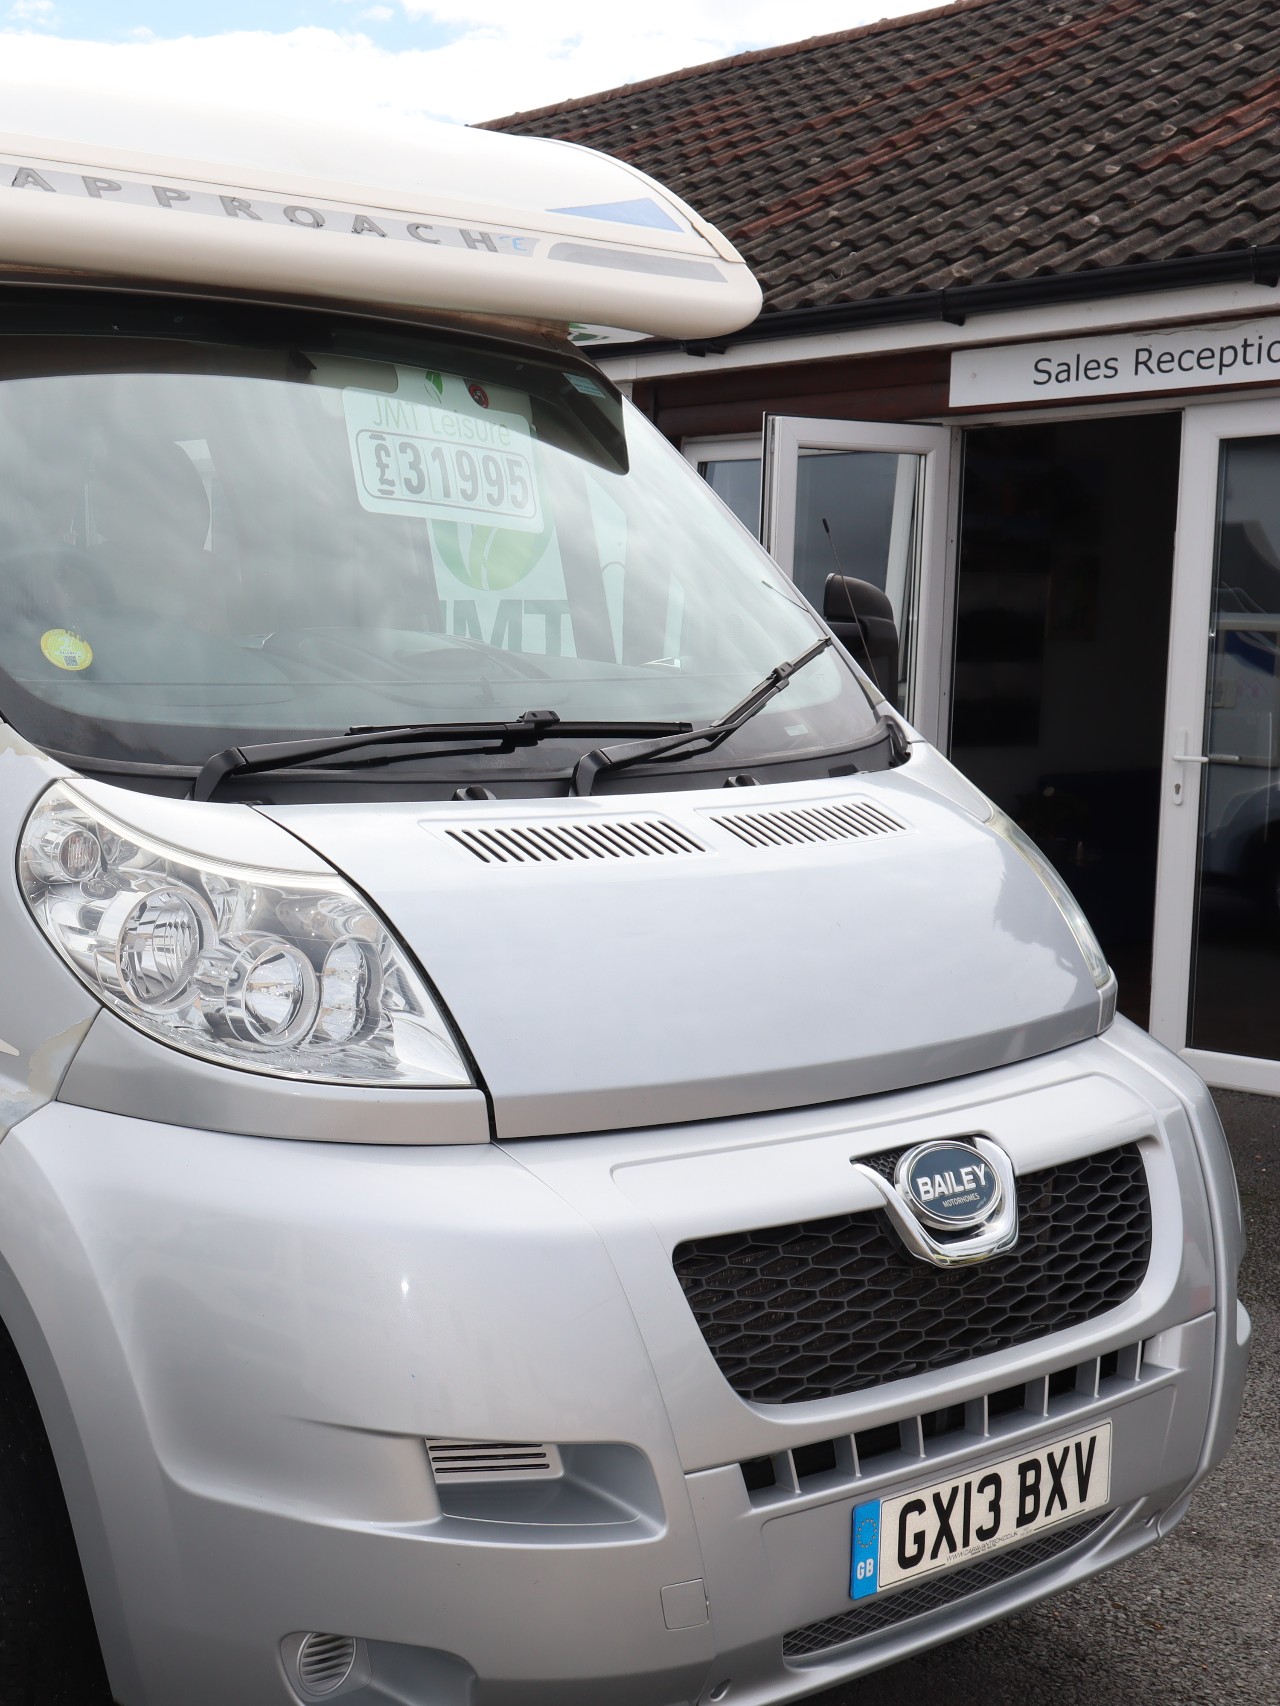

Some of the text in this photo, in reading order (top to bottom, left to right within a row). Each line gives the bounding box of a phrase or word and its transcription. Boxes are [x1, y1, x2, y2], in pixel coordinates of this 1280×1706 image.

[11, 166, 499, 253] APPROACH
[1033, 355, 1119, 386] Sales
[372, 396, 512, 446] JMT Leisure
[371, 437, 530, 510] £31995
[916, 1163, 989, 1204] BAILEY
[941, 1192, 981, 1208] MOTORHOMES
[897, 1435, 1098, 1570] GX13 BXV
[856, 1557, 875, 1581] GB
